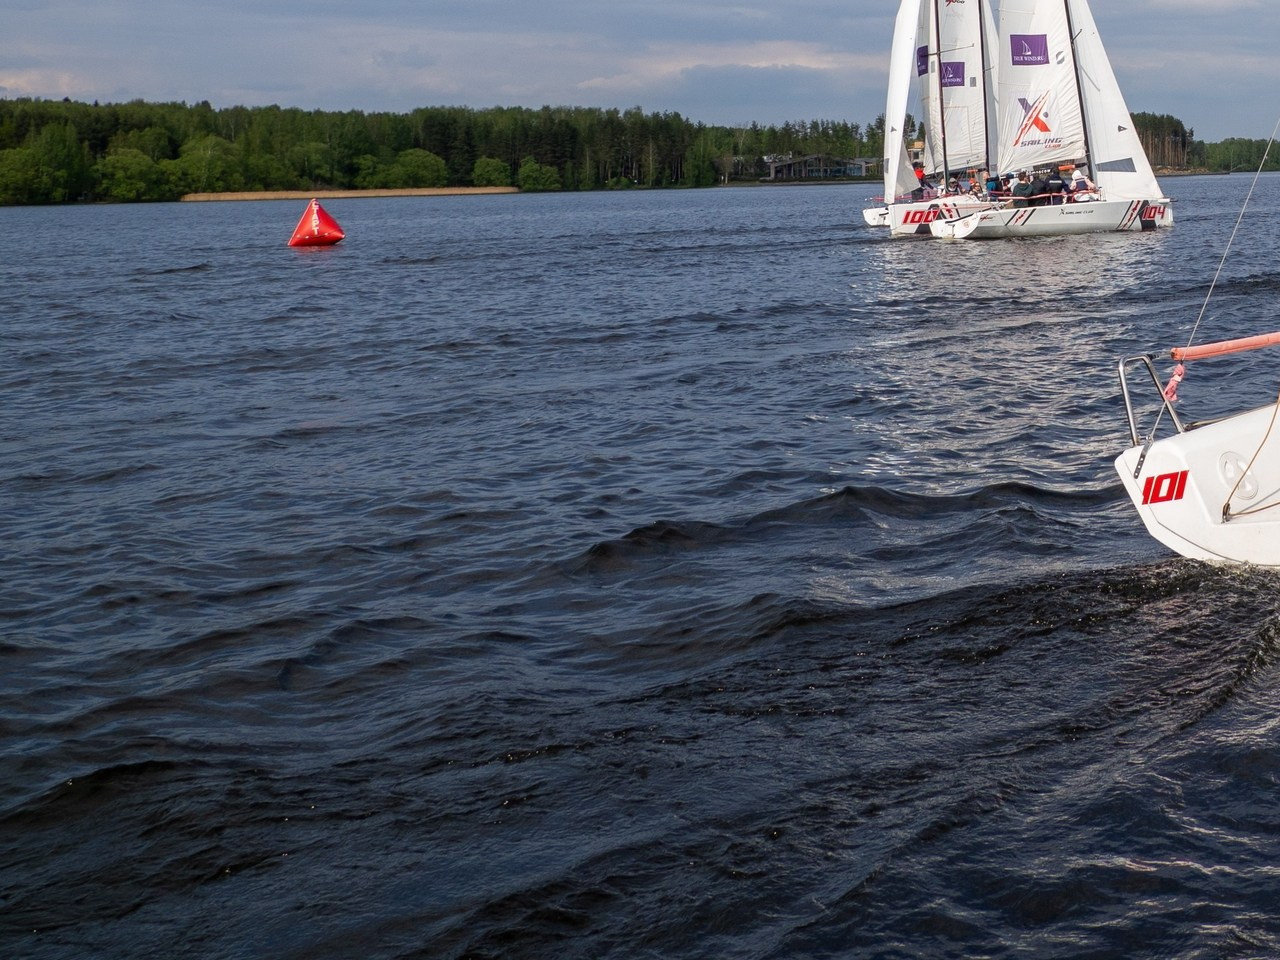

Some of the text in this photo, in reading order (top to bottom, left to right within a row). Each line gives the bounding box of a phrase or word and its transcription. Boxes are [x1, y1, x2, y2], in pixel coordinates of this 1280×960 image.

[1020, 137, 1063, 147] SAILING
[311, 200, 320, 235] СТАРТ
[1142, 206, 1166, 220] 104
[1142, 470, 1190, 505] 101
